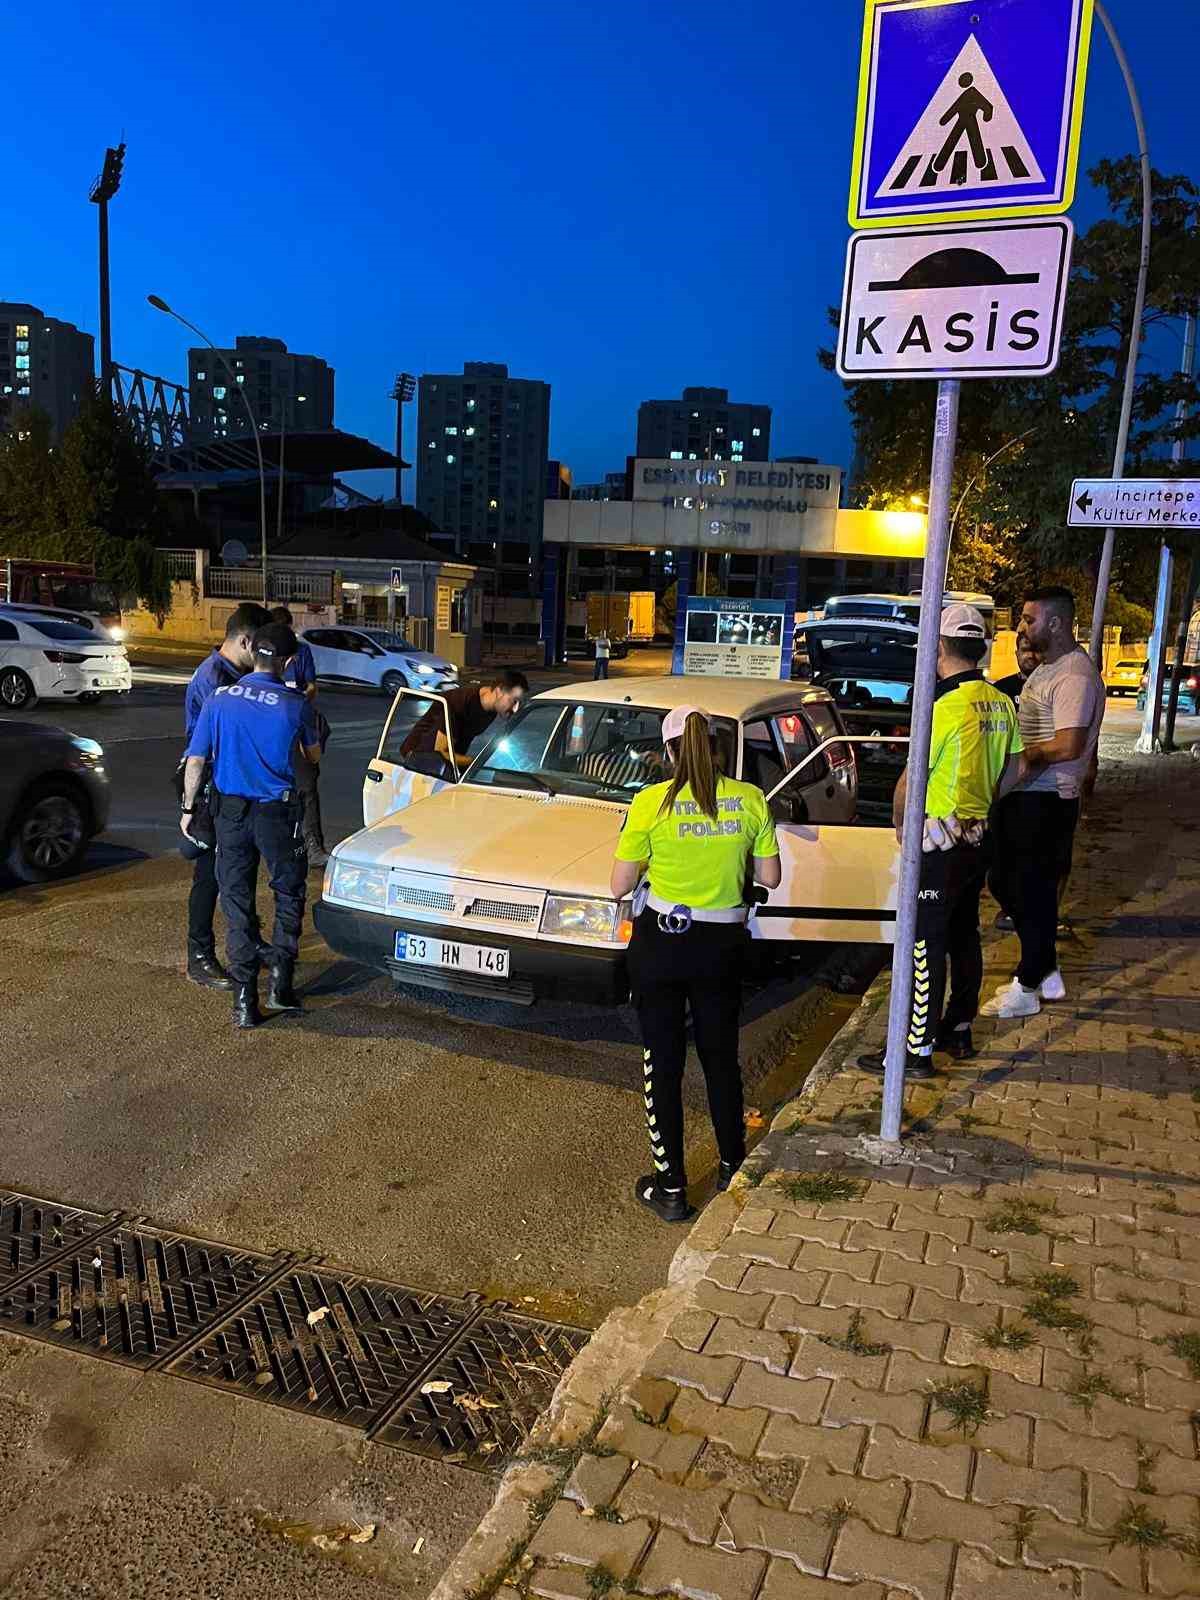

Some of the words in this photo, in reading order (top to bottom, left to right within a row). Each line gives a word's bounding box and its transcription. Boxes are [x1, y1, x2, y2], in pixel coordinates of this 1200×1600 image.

[855, 301, 1041, 355] KASİS
[1115, 485, 1195, 506] İncirtepe
[1093, 507, 1143, 521] Kültür
[1147, 508, 1200, 522] Merke
[214, 685, 280, 706] POLİS
[409, 938, 426, 958] 53
[441, 943, 461, 966] HN
[477, 950, 505, 972] 148
